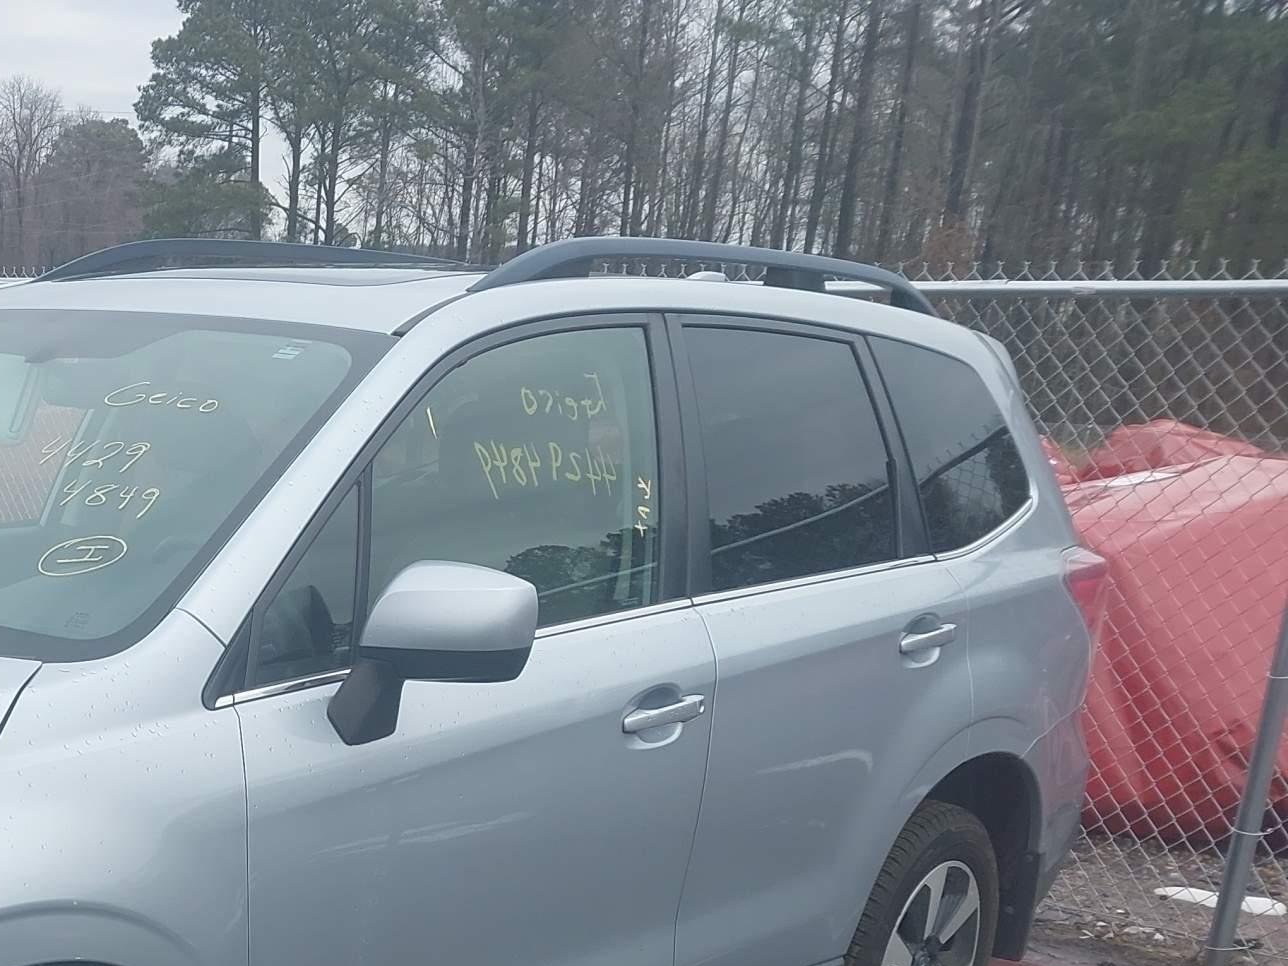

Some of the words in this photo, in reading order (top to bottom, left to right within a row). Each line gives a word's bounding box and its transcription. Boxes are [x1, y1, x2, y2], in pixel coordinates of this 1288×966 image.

[104, 381, 219, 413] Geico
[38, 435, 152, 473] 4429
[59, 479, 161, 520] 4849
